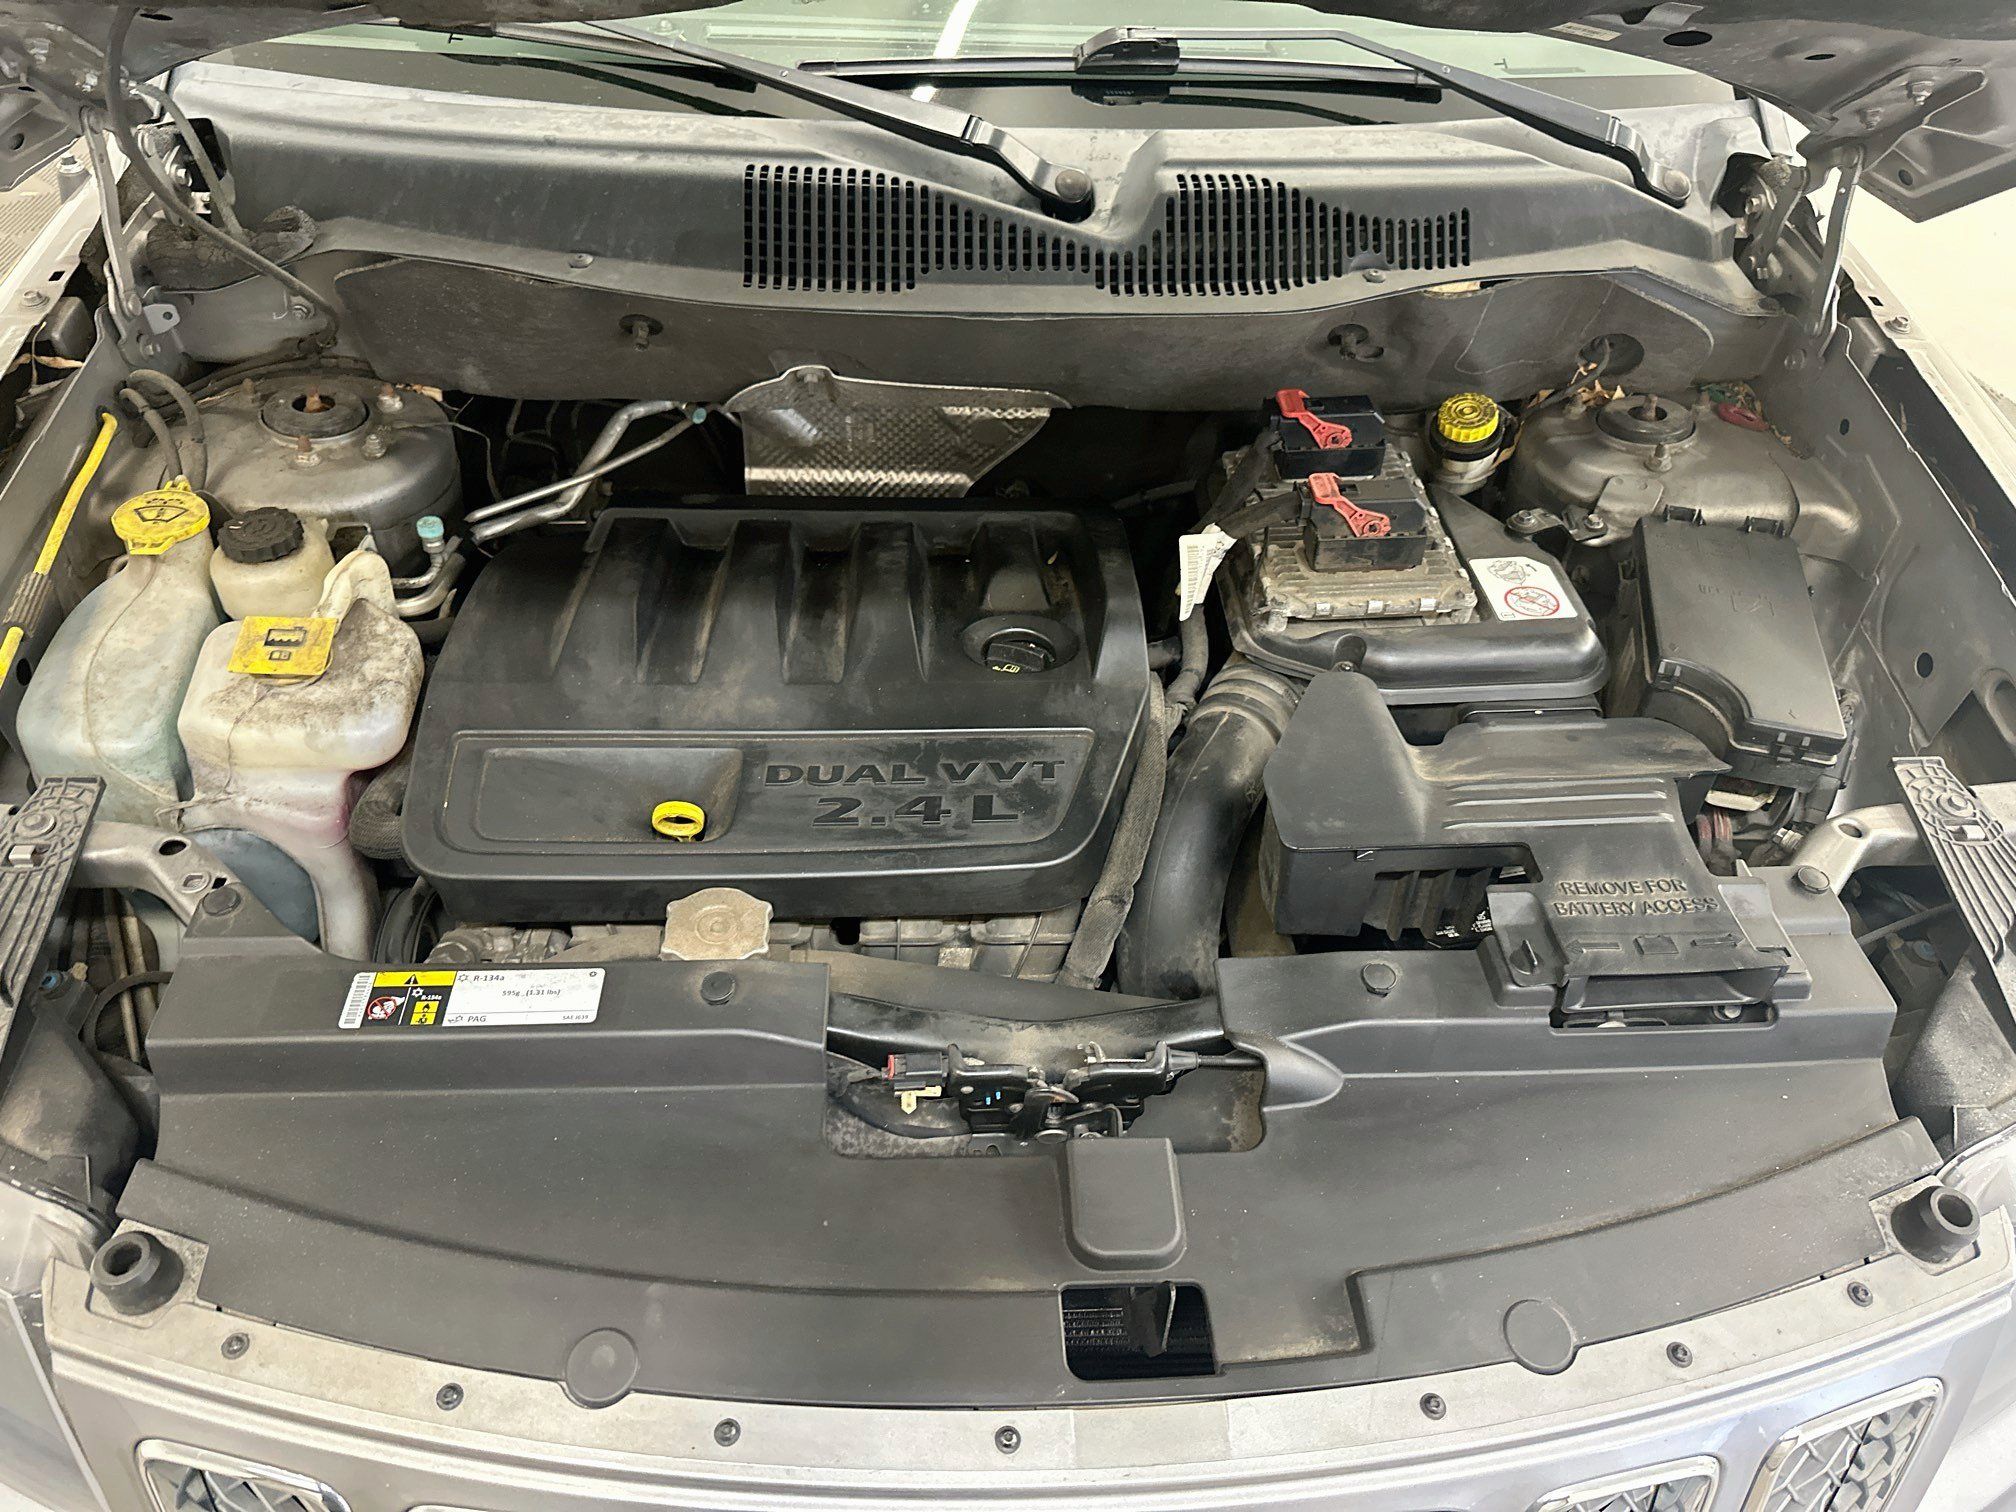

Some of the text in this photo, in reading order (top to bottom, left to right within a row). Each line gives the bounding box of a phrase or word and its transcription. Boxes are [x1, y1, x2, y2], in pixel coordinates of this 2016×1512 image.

[765, 760, 1065, 786] DUAL VVT
[1560, 879, 1687, 896] REMOVE FOR
[1553, 897, 1718, 917] BATTERY ACCESS
[473, 974, 505, 982] R-134a
[525, 989, 545, 997] (1.31
[467, 1015, 487, 1023] PAG
